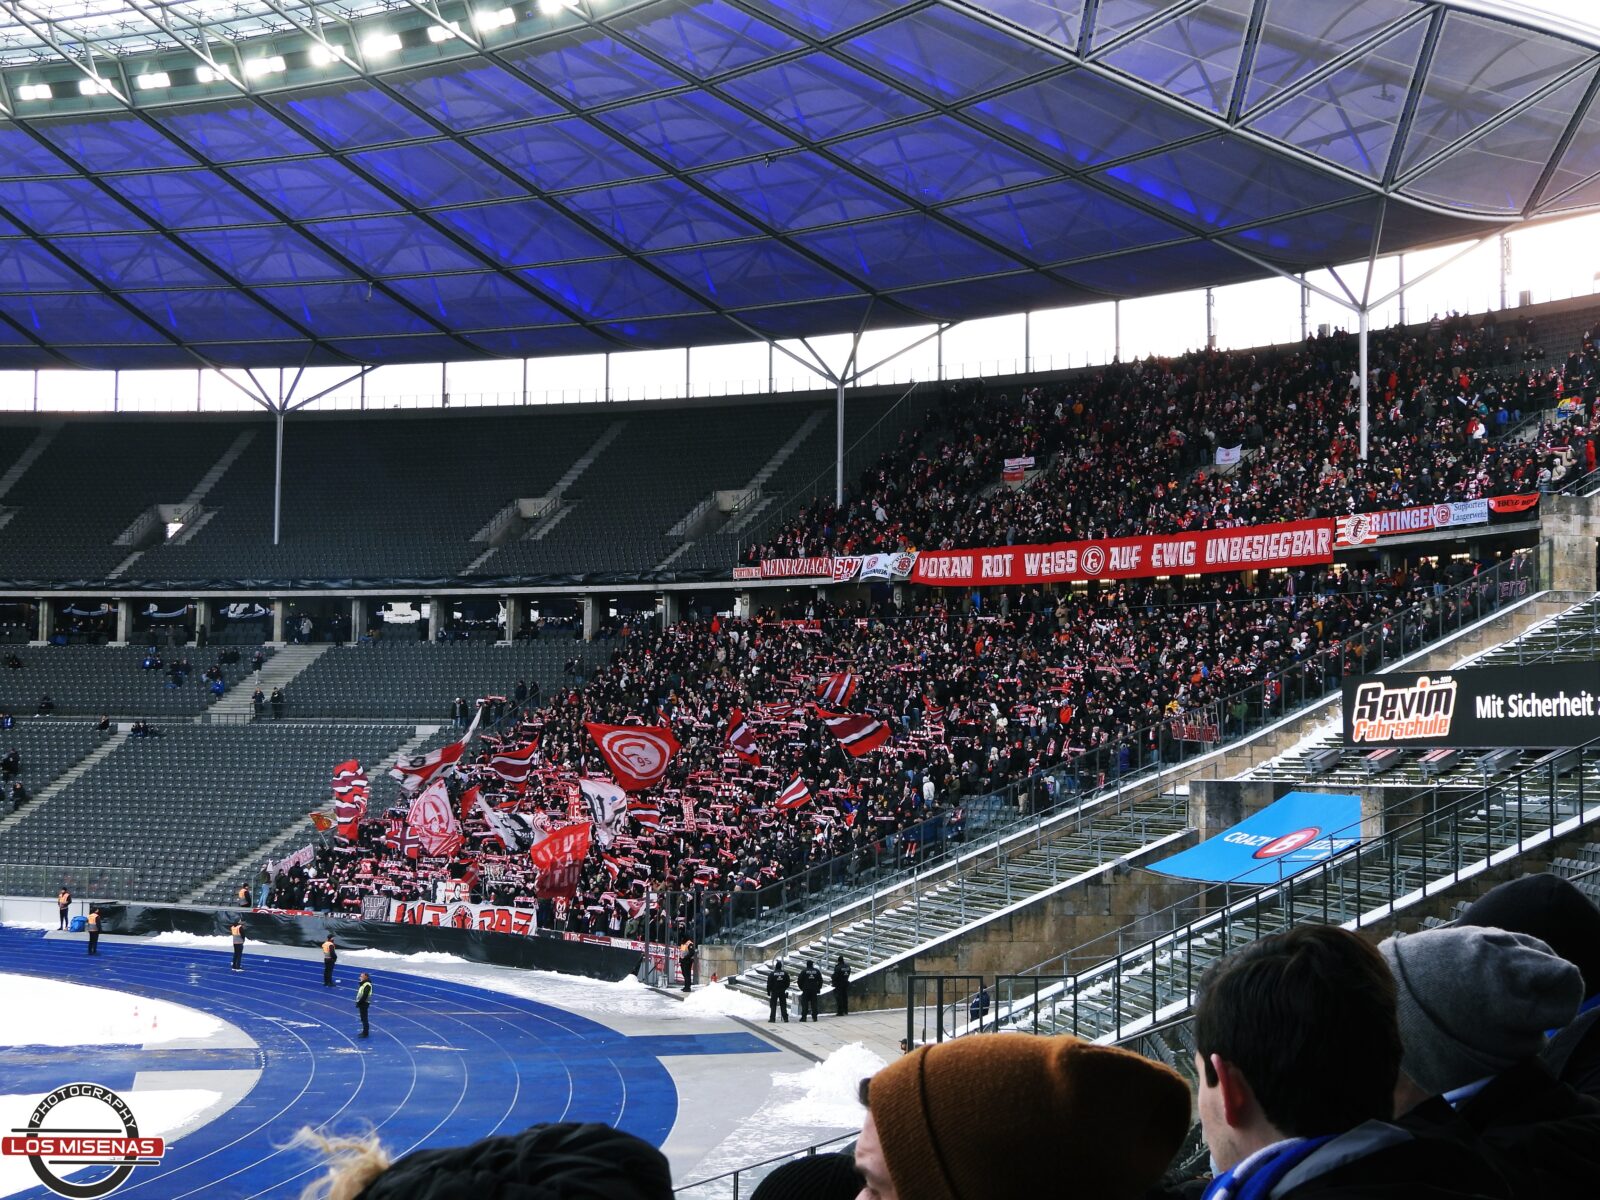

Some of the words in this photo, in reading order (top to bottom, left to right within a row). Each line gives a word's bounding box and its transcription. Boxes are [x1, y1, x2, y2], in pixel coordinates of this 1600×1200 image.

[761, 556, 834, 577] MEINERZHAGEN
[918, 555, 974, 579] VORAN
[981, 553, 1014, 578] ROT
[1024, 549, 1078, 577] WEISS
[1109, 544, 1143, 571] AUF
[1151, 540, 1197, 568] EWIG
[1205, 528, 1331, 563] UNBESIEGBAR
[1354, 679, 1455, 722] Sevim
[1475, 694, 1504, 719] Mit
[1508, 690, 1594, 718] Sicherheit
[1223, 831, 1277, 847] CRAZY
